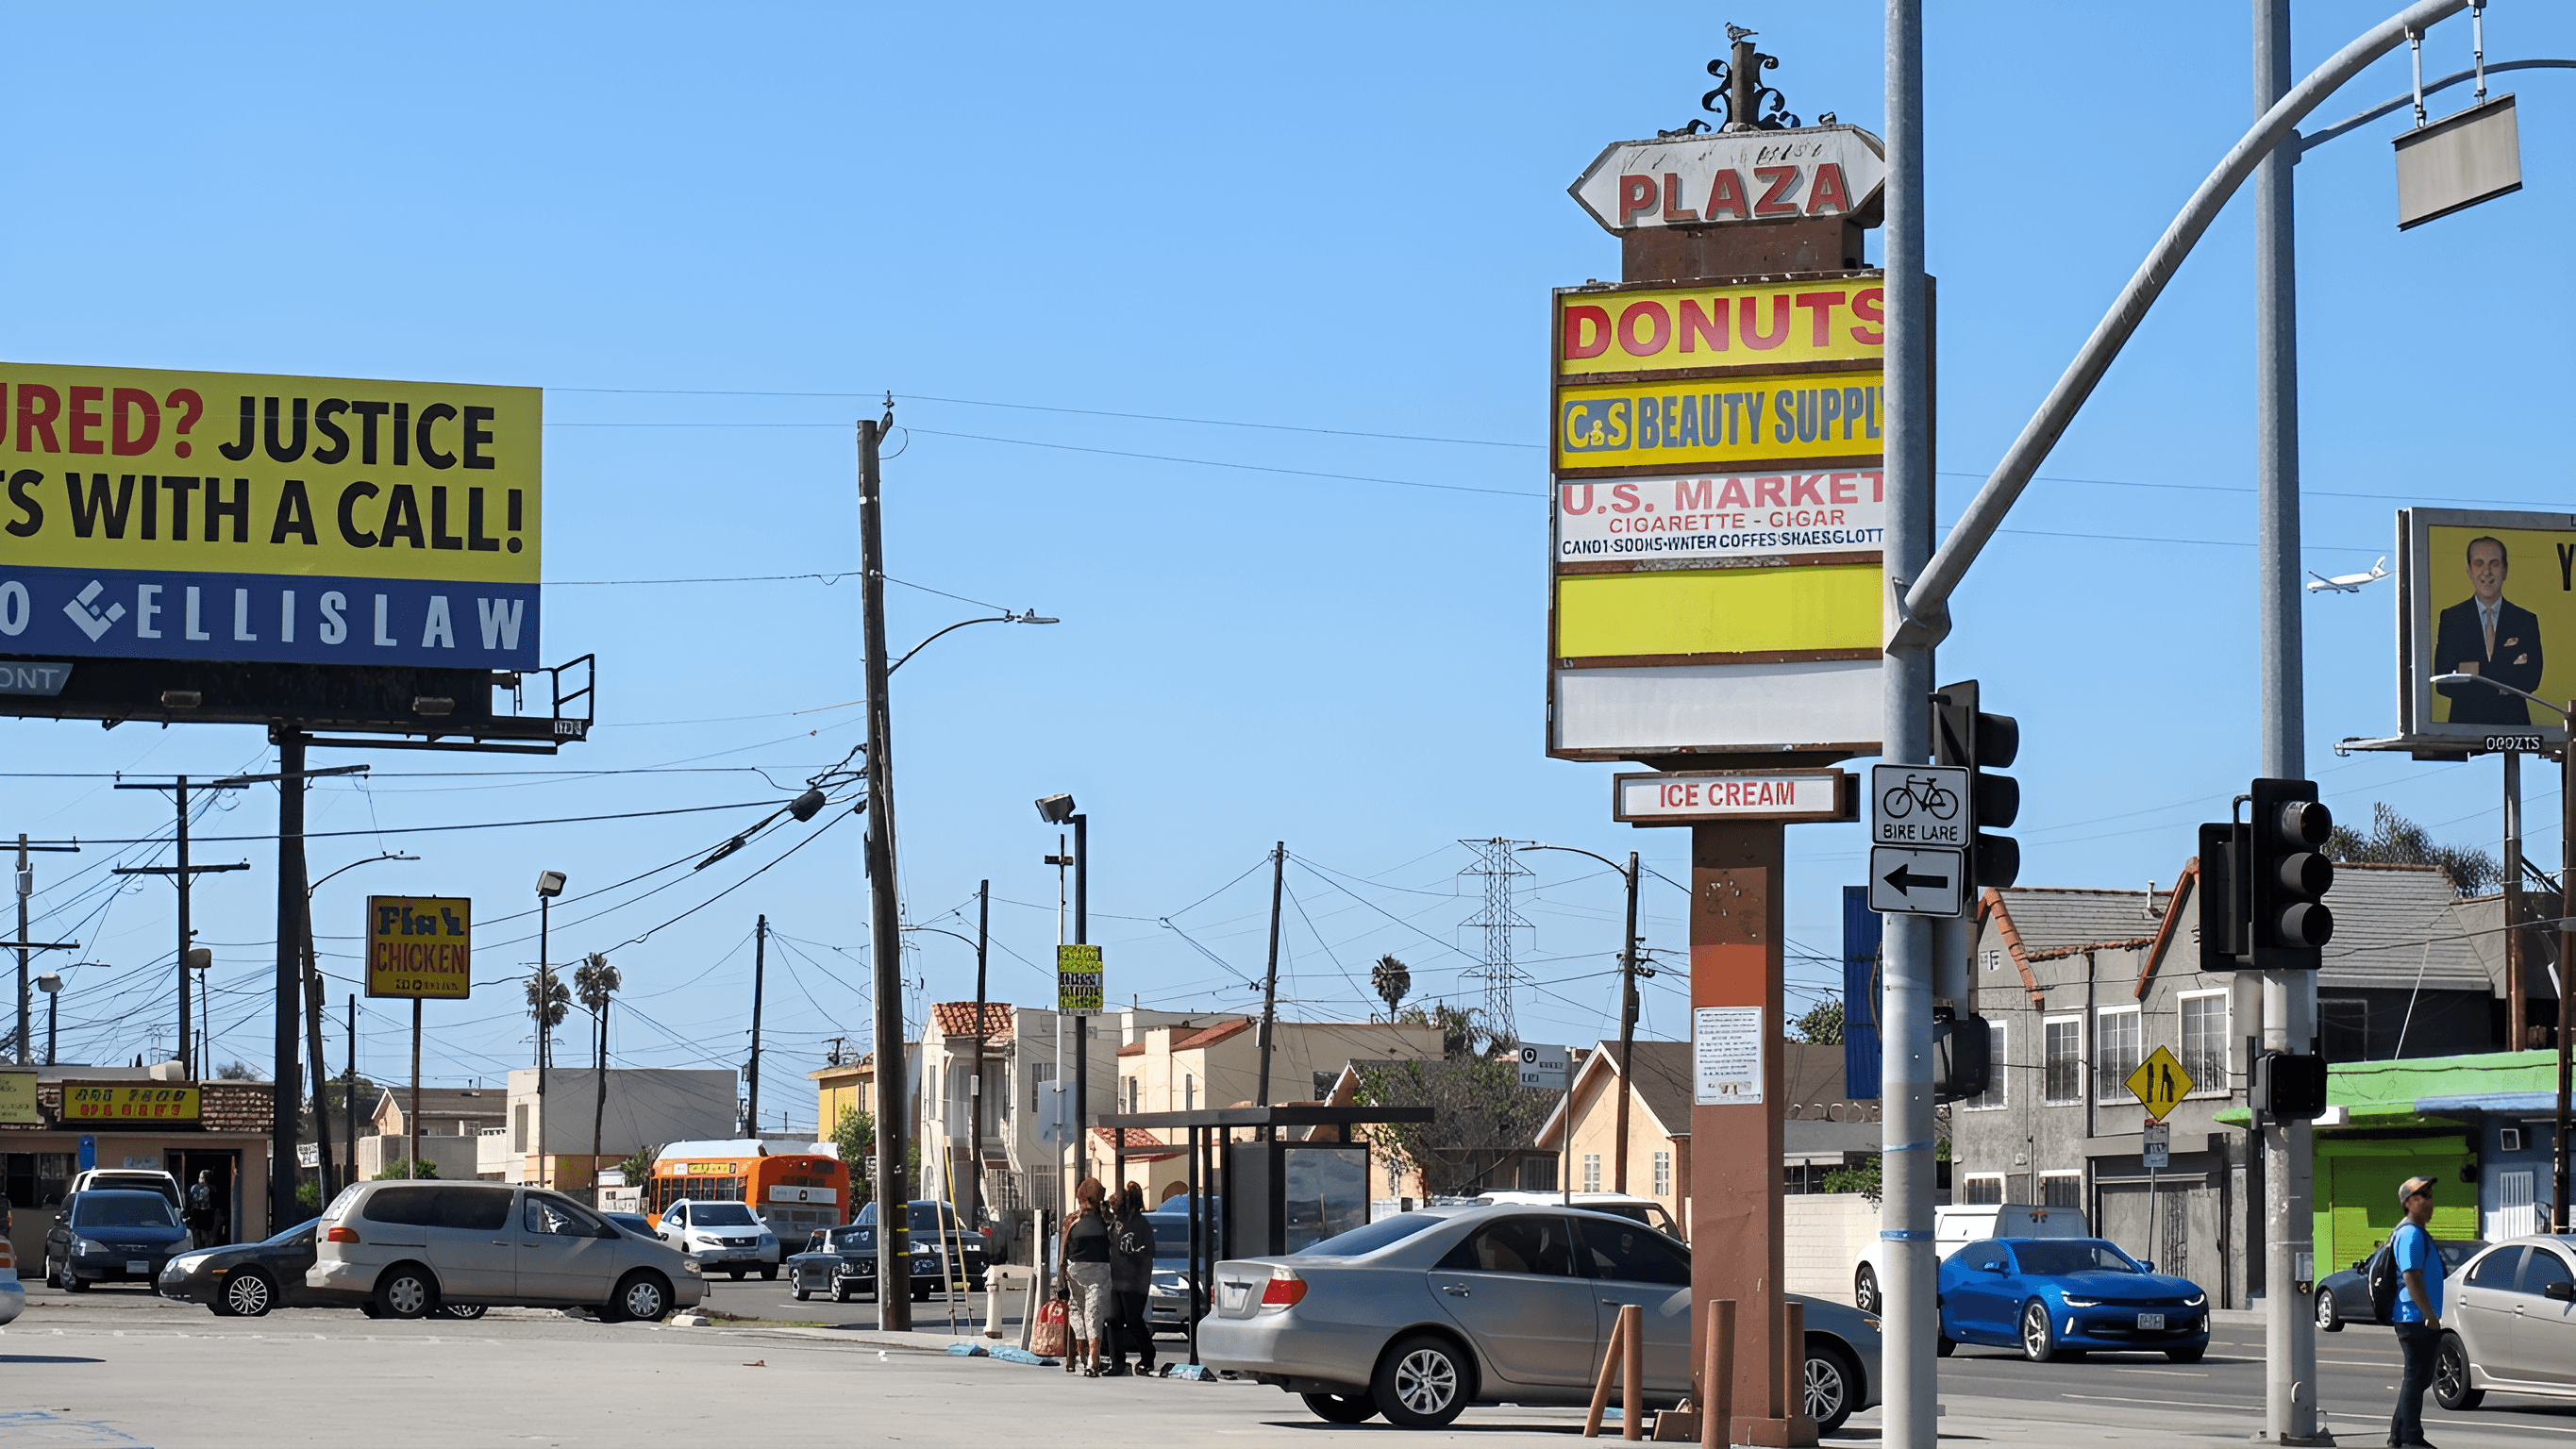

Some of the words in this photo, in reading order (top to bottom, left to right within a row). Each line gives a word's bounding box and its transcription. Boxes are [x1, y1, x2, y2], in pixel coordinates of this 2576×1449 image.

[1619, 162, 1848, 225] PLAZA
[1564, 287, 1884, 360] DONUTS
[0, 383, 204, 458] RED?
[218, 395, 495, 471] JUSTICE
[1638, 391, 1765, 449] BEAUTY
[1773, 386, 1884, 444] SUPPL
[64, 472, 250, 542] WITH
[269, 479, 318, 545] A
[337, 480, 524, 555] CALL!
[1562, 482, 1655, 516] U.S.
[1674, 471, 1884, 511] MARKET
[1660, 783, 1698, 808] ICE
[1708, 781, 1795, 807] CREAM
[377, 941, 465, 974] CHICKEN
